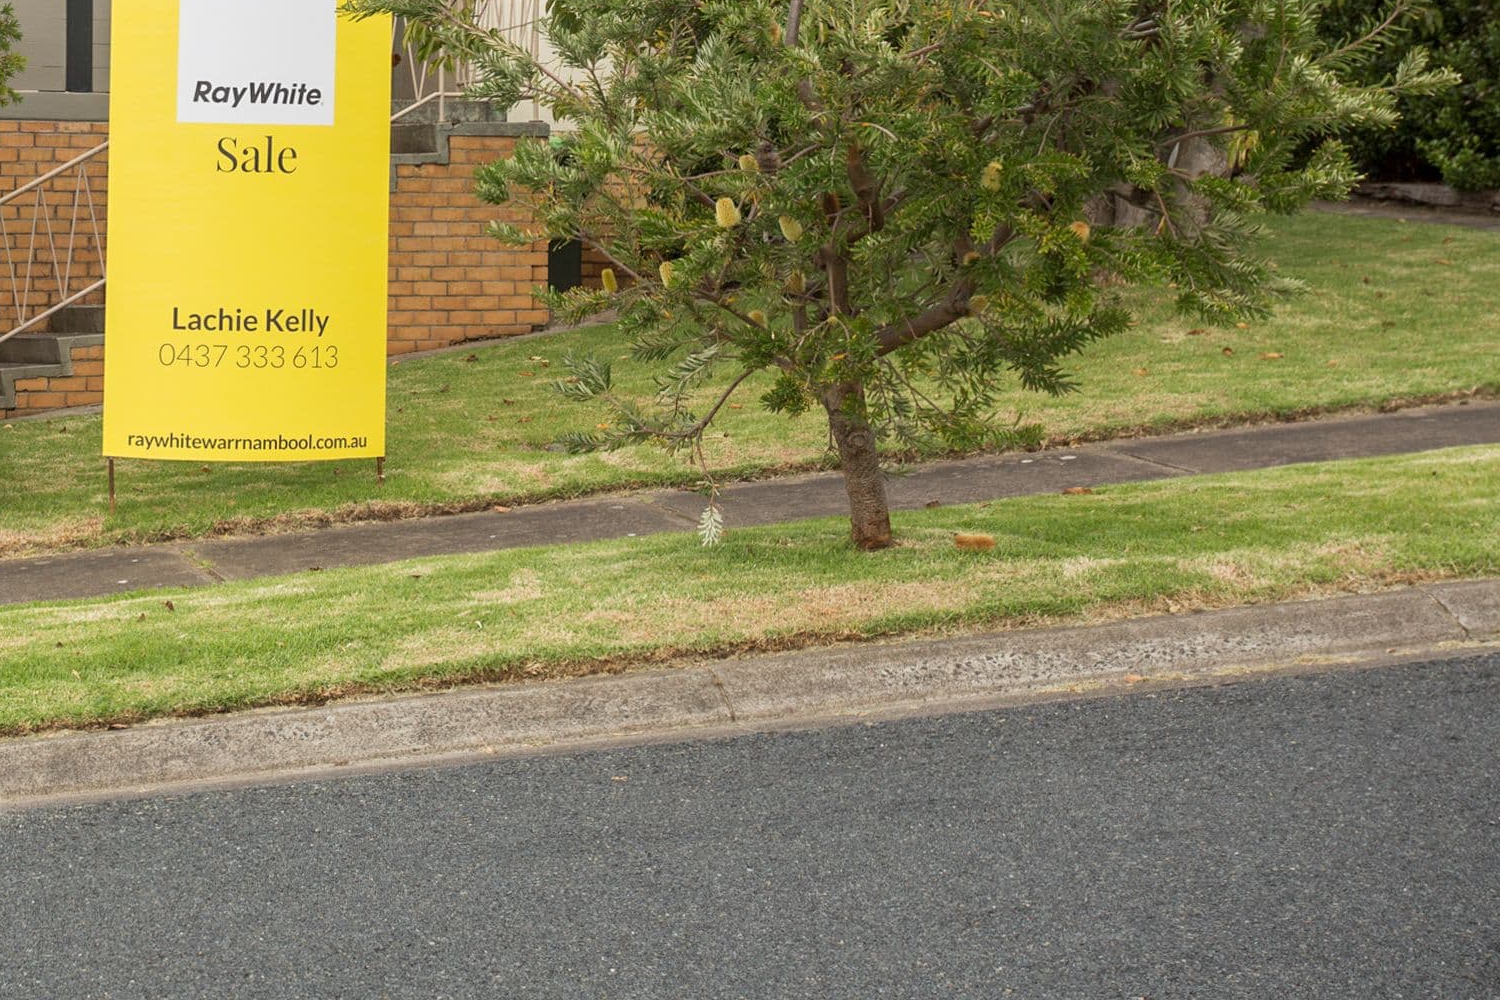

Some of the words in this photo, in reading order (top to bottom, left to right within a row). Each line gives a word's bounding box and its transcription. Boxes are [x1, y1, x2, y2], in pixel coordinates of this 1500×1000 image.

[216, 136, 298, 175] Sale
[172, 307, 258, 332] Lachie
[265, 309, 330, 337] Kelly
[158, 343, 228, 368] 0437
[235, 345, 285, 369] 333
[292, 345, 339, 369] 613
[127, 432, 368, 451] raywhitewarrnambool.com.au
